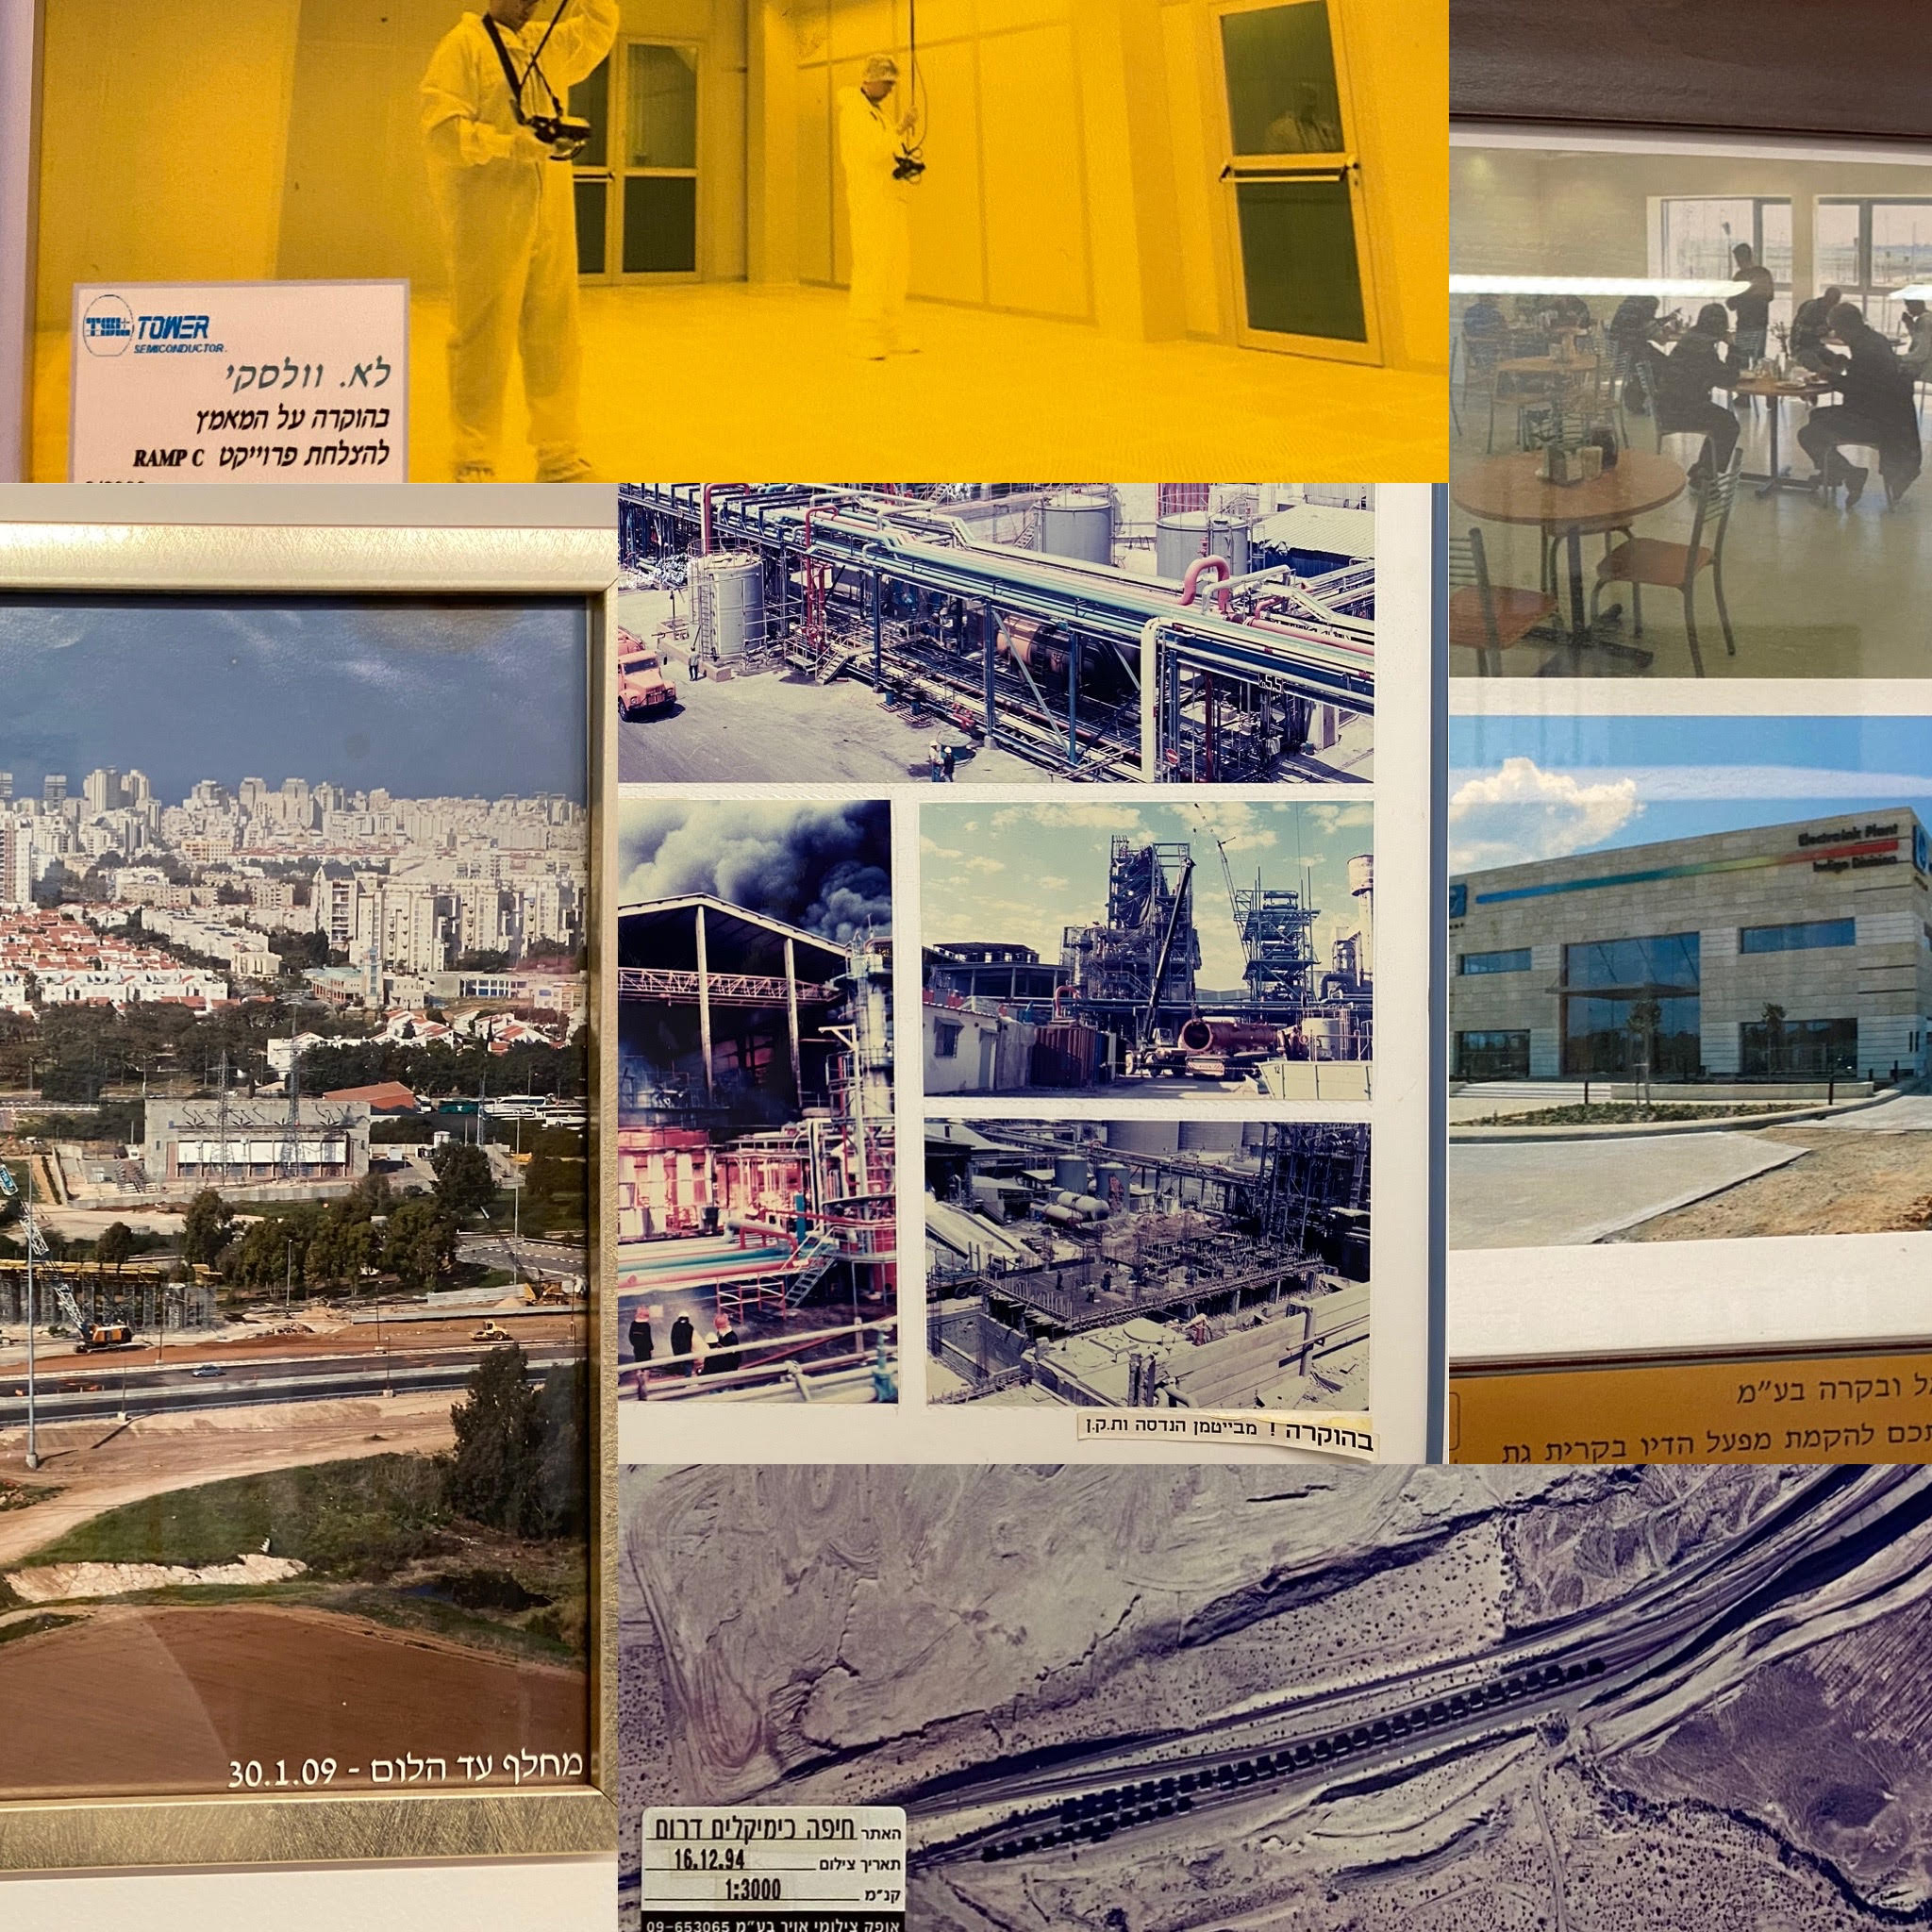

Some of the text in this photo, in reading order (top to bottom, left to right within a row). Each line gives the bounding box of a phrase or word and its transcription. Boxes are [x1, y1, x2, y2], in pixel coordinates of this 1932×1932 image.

[138, 315, 209, 340] TOWER
[196, 402, 391, 435] בהוקרה על המאמץ
[132, 448, 205, 468] RAMP C
[219, 438, 391, 471] להצלחת פרוייקט
[1818, 1376, 1901, 1405] ובקרה
[1135, 1419, 1187, 1433] הנדסה
[1270, 1422, 1276, 1437] !
[1284, 1424, 1374, 1453] בהוקרה
[1784, 1422, 1875, 1453] להקמת
[1501, 1443, 1532, 1464] גת
[1544, 1439, 1627, 1463] בקרית
[1640, 1436, 1694, 1457] הדיו
[1706, 1429, 1772, 1454] מפעל
[227, 1757, 337, 1789] 30.1.09
[370, 1751, 447, 1784] הלום
[457, 1752, 493, 1783] עד
[501, 1747, 584, 1785] מחלף
[656, 1815, 902, 1845] האתר חיפה כימיקלים דרום
[674, 1848, 901, 1874] תאריך צילום 16.12.94
[724, 1877, 782, 1901] 1:3000
